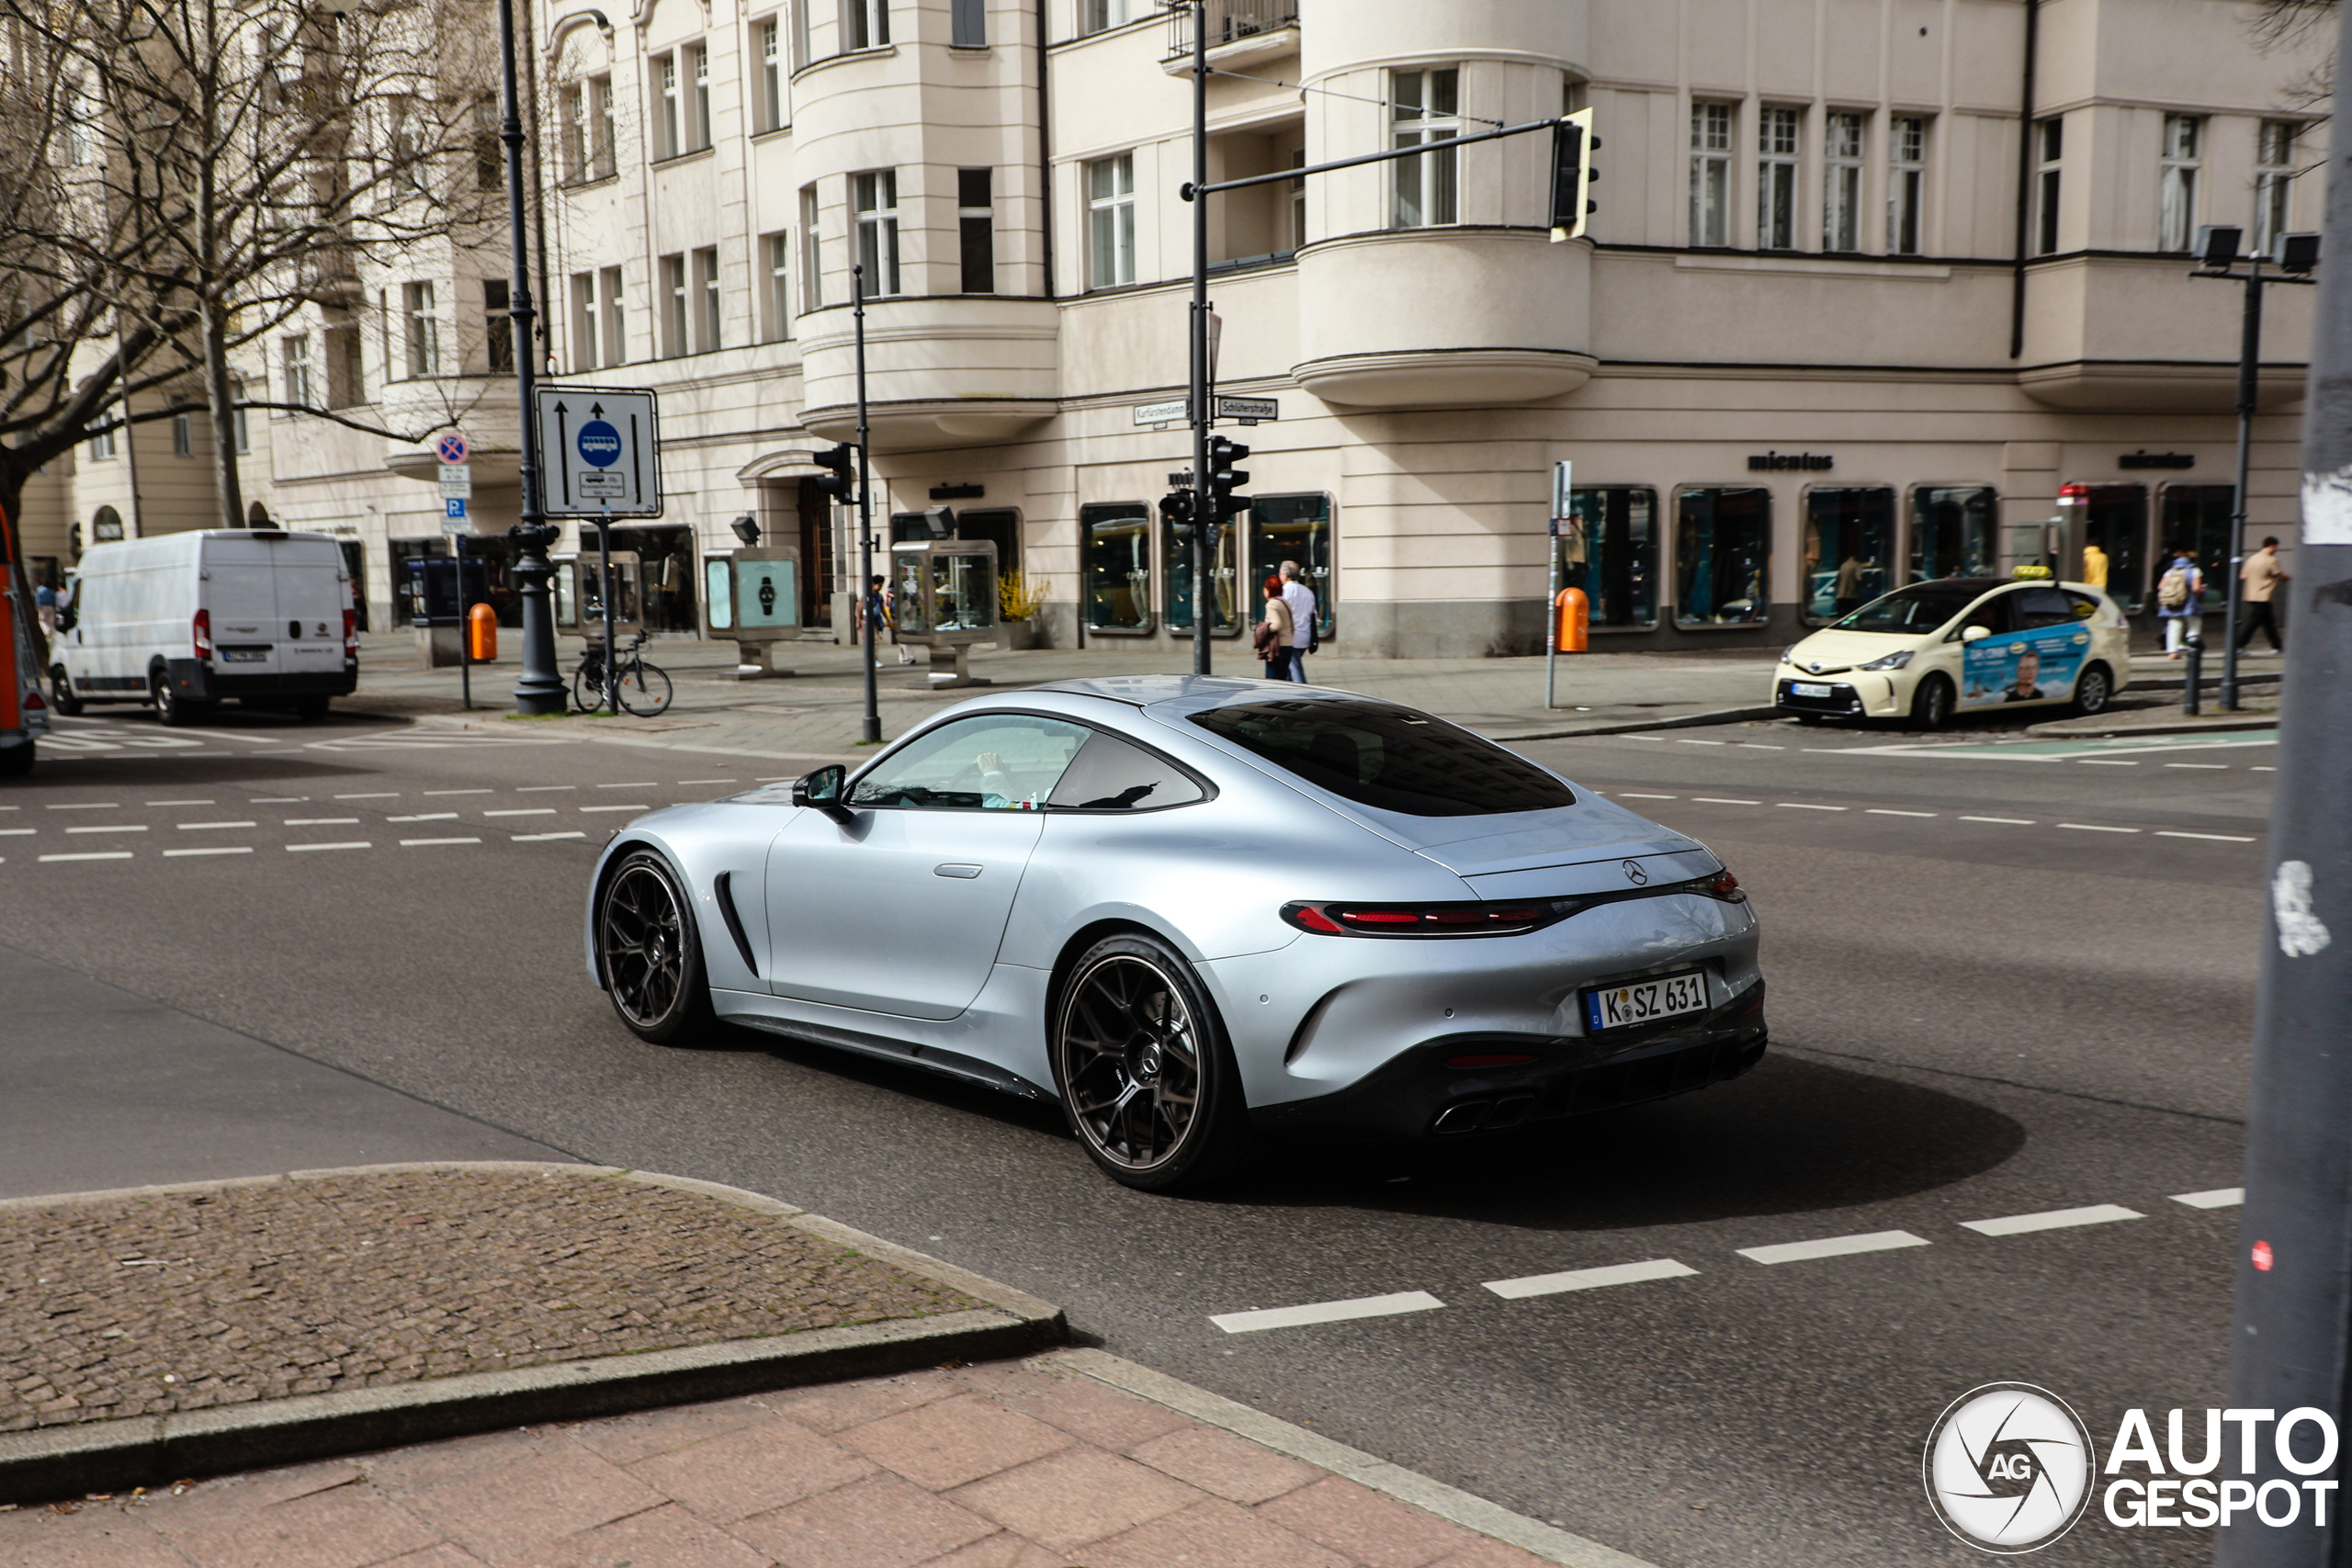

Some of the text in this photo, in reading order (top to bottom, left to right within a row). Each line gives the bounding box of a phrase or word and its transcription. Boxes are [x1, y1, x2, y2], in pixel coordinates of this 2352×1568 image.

[1136, 404, 1185, 418] Kurfürstendamm
[1747, 449, 1833, 470] mientus
[1605, 976, 1702, 1023] K SZ 631
